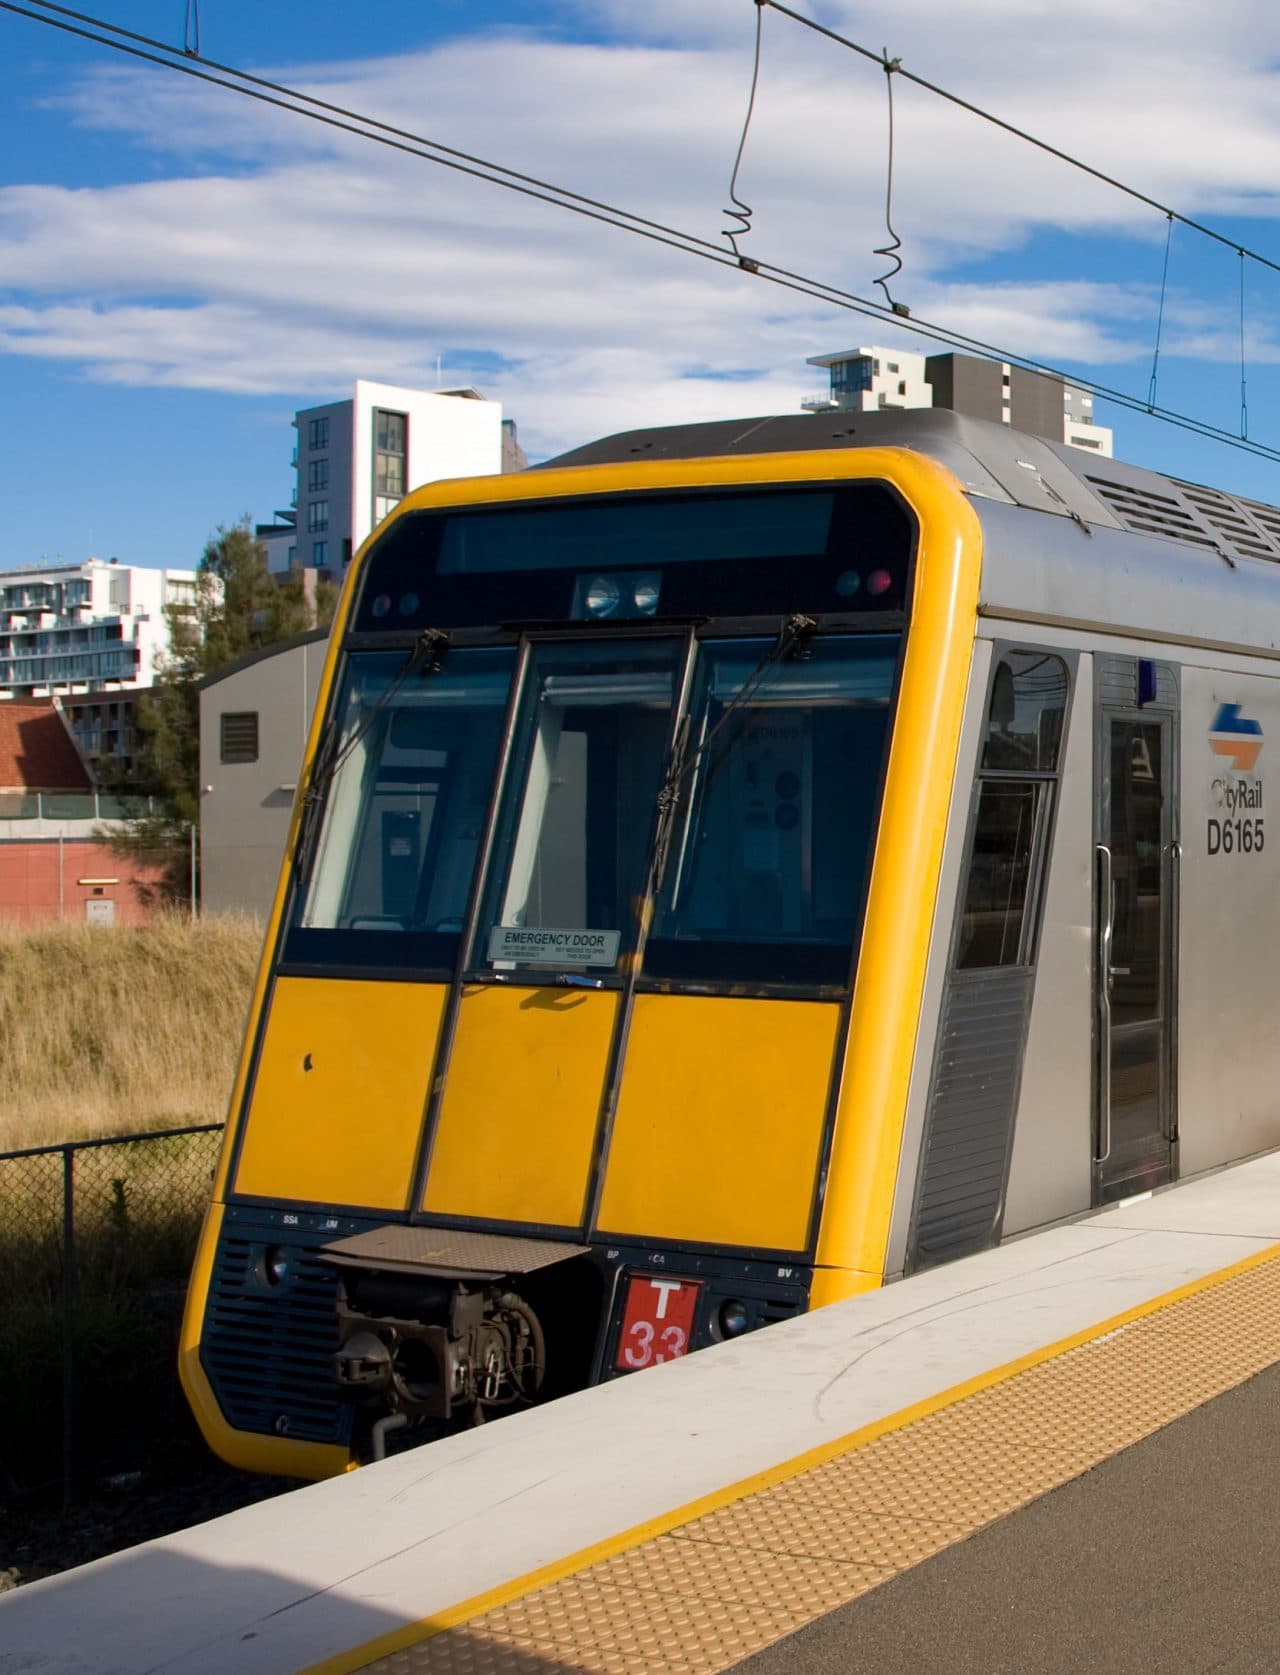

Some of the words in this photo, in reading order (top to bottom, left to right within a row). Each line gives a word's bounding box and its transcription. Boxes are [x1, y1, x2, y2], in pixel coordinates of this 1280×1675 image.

[1207, 818, 1264, 856] D6165
[504, 932, 571, 945] EMERGENCY
[573, 935, 605, 946] DOOR
[777, 1268, 792, 1278] BV
[651, 1279, 681, 1319] T
[624, 1320, 686, 1368] 33
